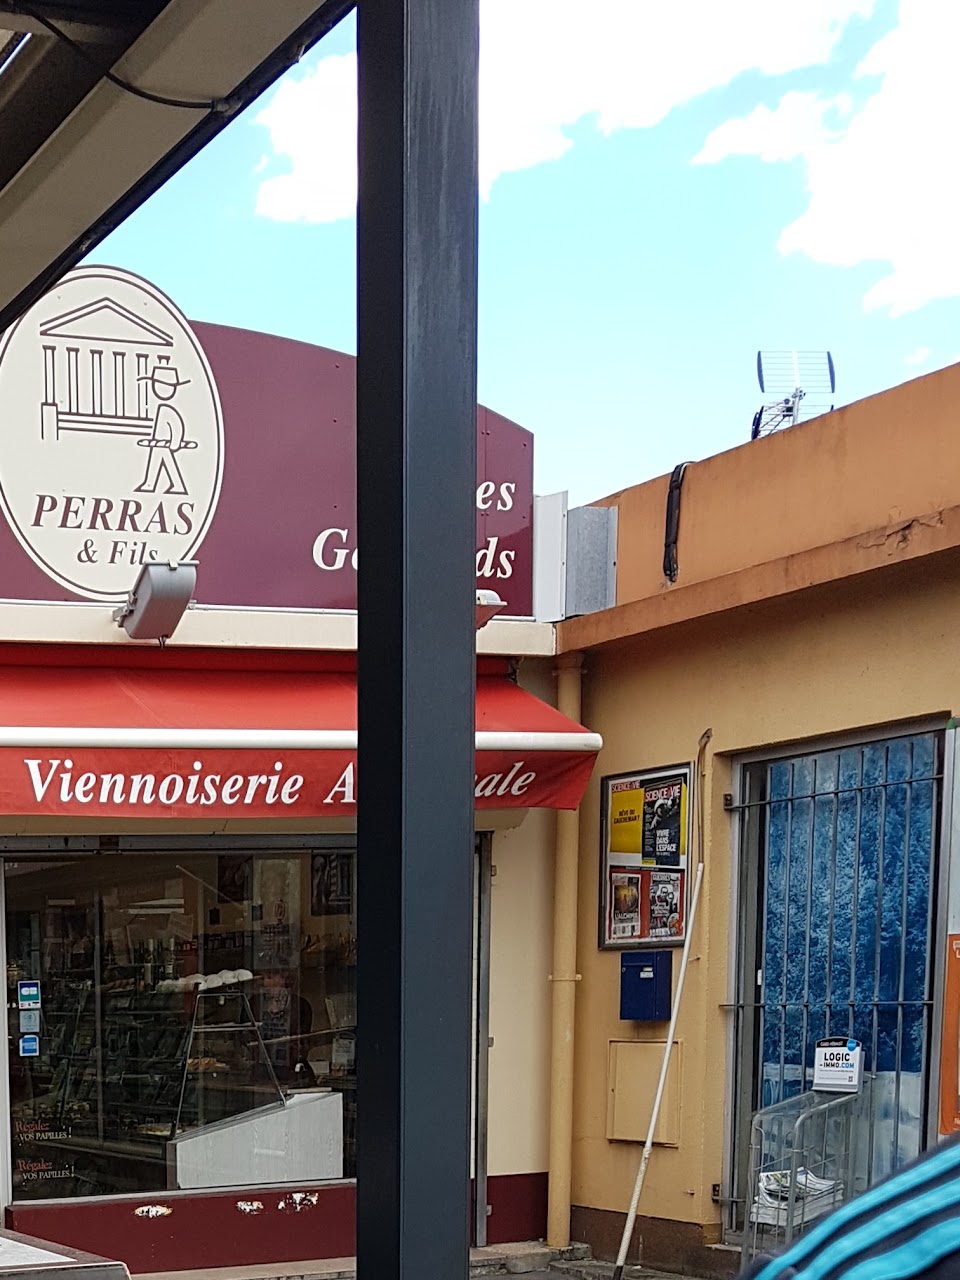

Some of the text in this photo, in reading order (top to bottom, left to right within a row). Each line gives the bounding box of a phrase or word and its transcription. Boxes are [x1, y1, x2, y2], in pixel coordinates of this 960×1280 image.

[30, 494, 195, 535] PERRAS
[77, 539, 159, 565] & Fils
[24, 759, 304, 805] Viennoiserie
[824, 1052, 851, 1062] LOGIC
[20, 1133, 35, 1141] VOS
[23, 1172, 38, 1180] VOS
